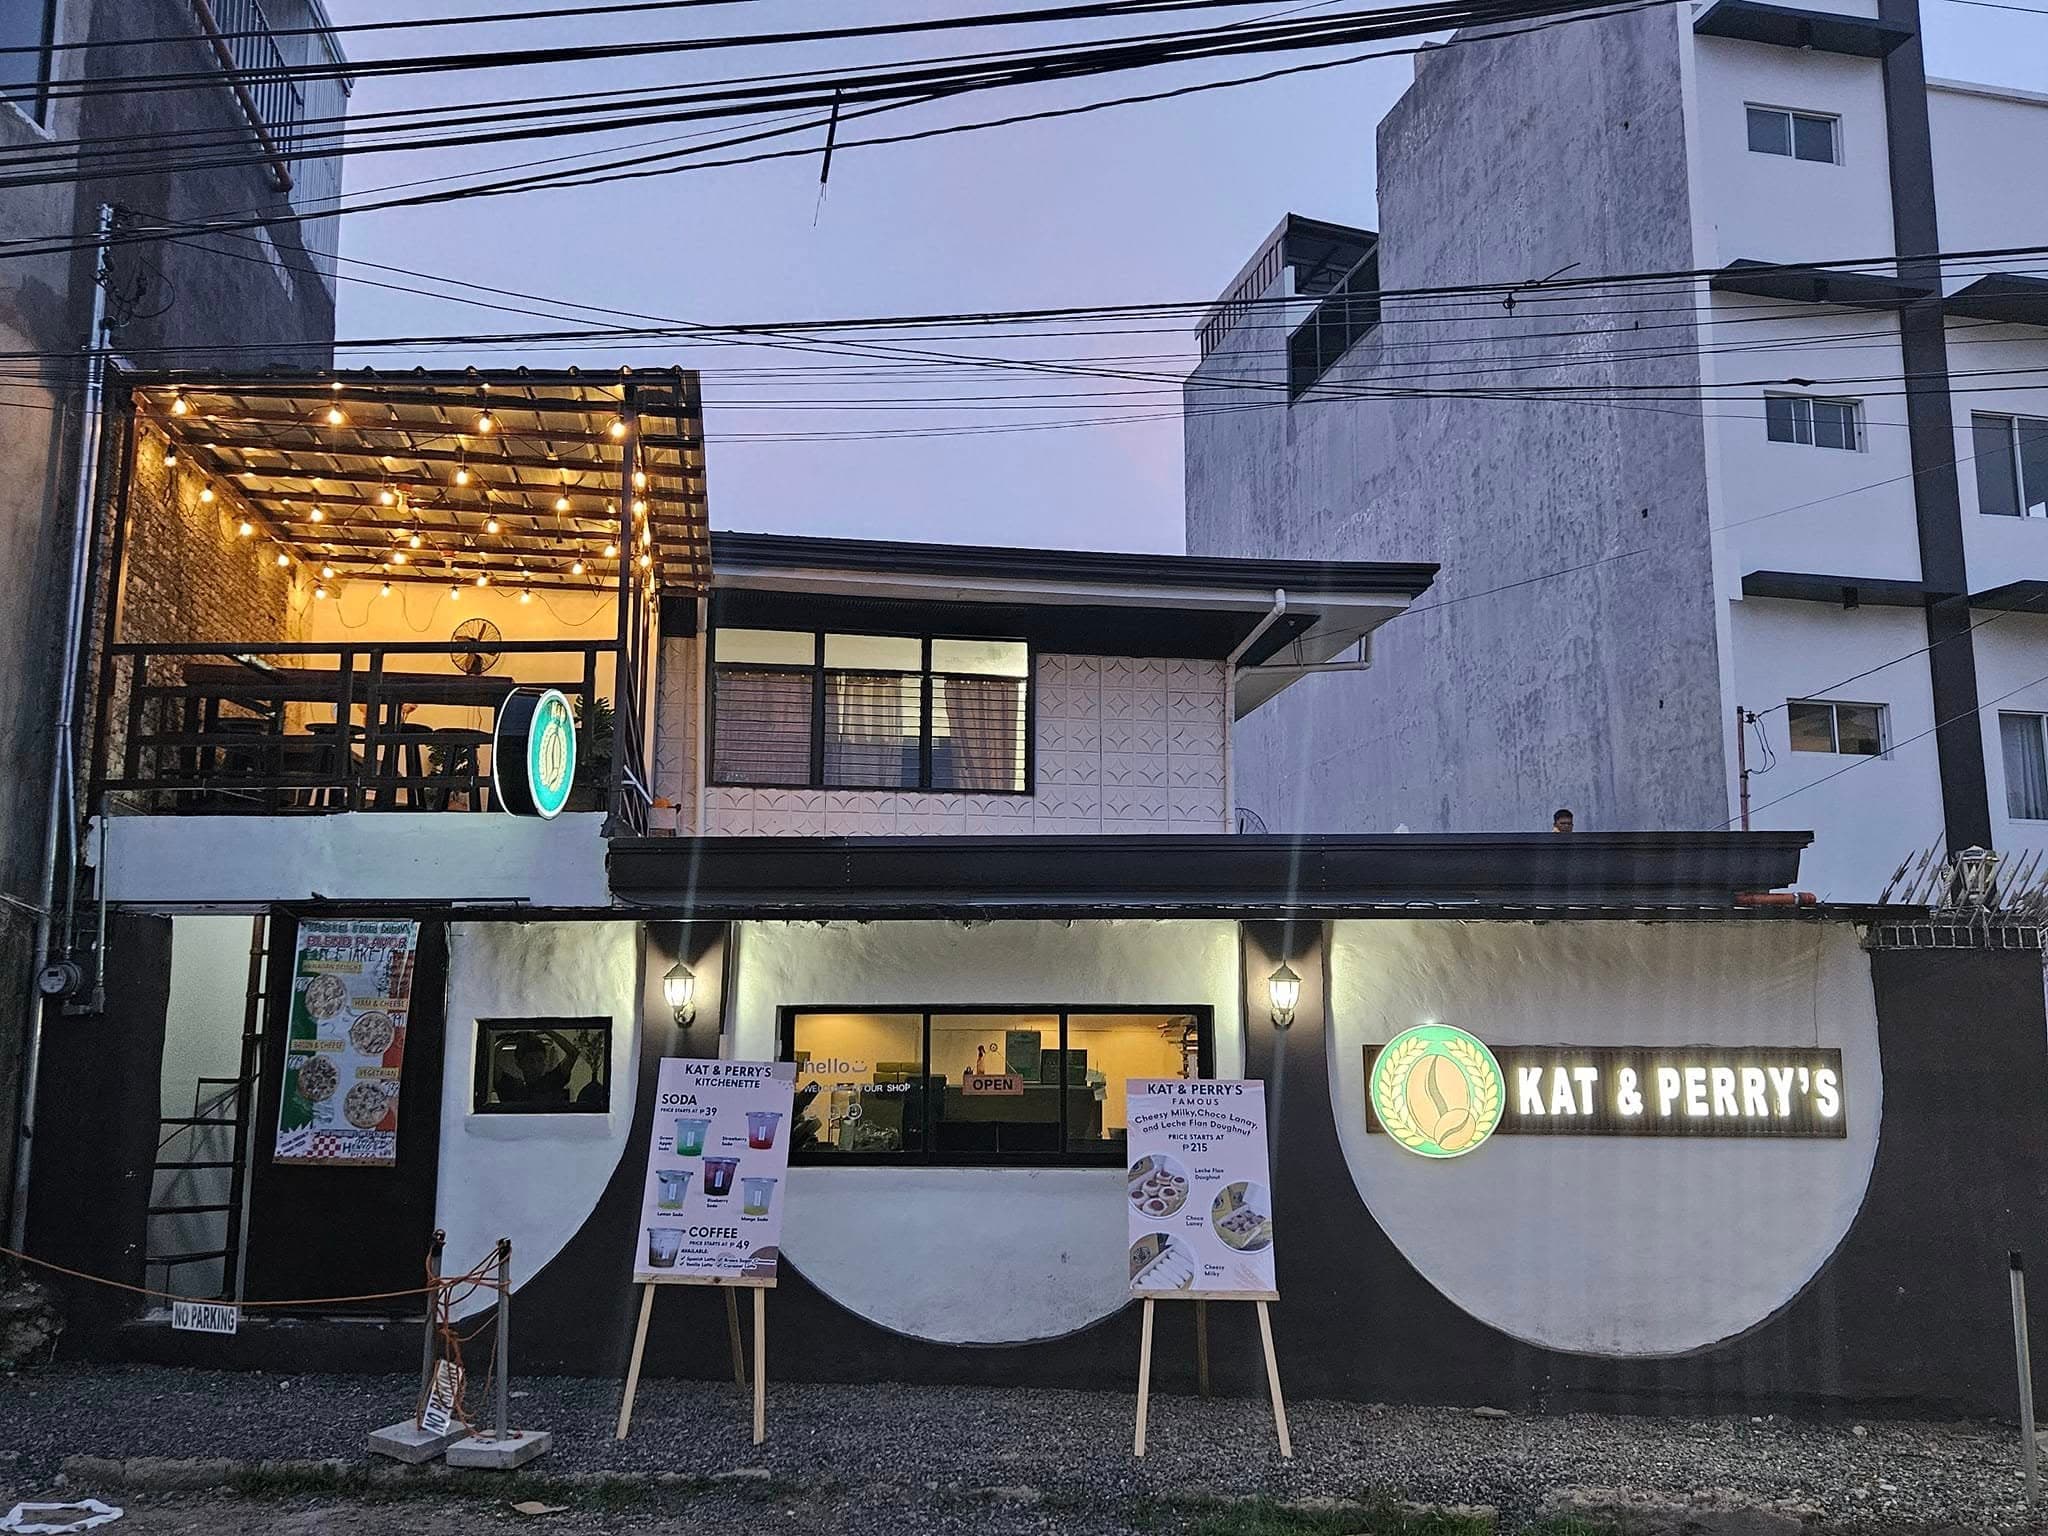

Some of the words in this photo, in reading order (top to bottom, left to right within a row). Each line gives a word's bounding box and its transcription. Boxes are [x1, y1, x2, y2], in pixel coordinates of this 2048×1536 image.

[306, 935, 351, 948] BLEND
[685, 1064, 709, 1075] KAT
[712, 1065, 721, 1075] &
[725, 1066, 772, 1077] PERRY'S
[805, 1058, 850, 1074] hello
[695, 1078, 760, 1088] KITCHENETTE
[864, 1084, 883, 1092] OUR
[886, 1082, 911, 1092] SHOP
[972, 1078, 1014, 1091] OPEN
[1148, 1084, 1173, 1094] KAT
[1178, 1084, 1187, 1094] &
[1191, 1084, 1243, 1095] PERRY'S
[1517, 1066, 1600, 1115] KAT
[1617, 1067, 1644, 1116] &
[1656, 1066, 1841, 1118] PERRY'S
[661, 1093, 697, 1105] SODA
[1134, 1111, 1168, 1124] Cheesy
[1142, 1123, 1159, 1133] and
[1161, 1120, 1187, 1129] Leche
[1189, 1119, 1208, 1127] Flan
[1210, 1120, 1251, 1136] Doughnut
[689, 1227, 738, 1238] COFFEE
[174, 1304, 189, 1327] NO
[191, 1305, 235, 1331] PARKING
[424, 1412, 446, 1433] NO
